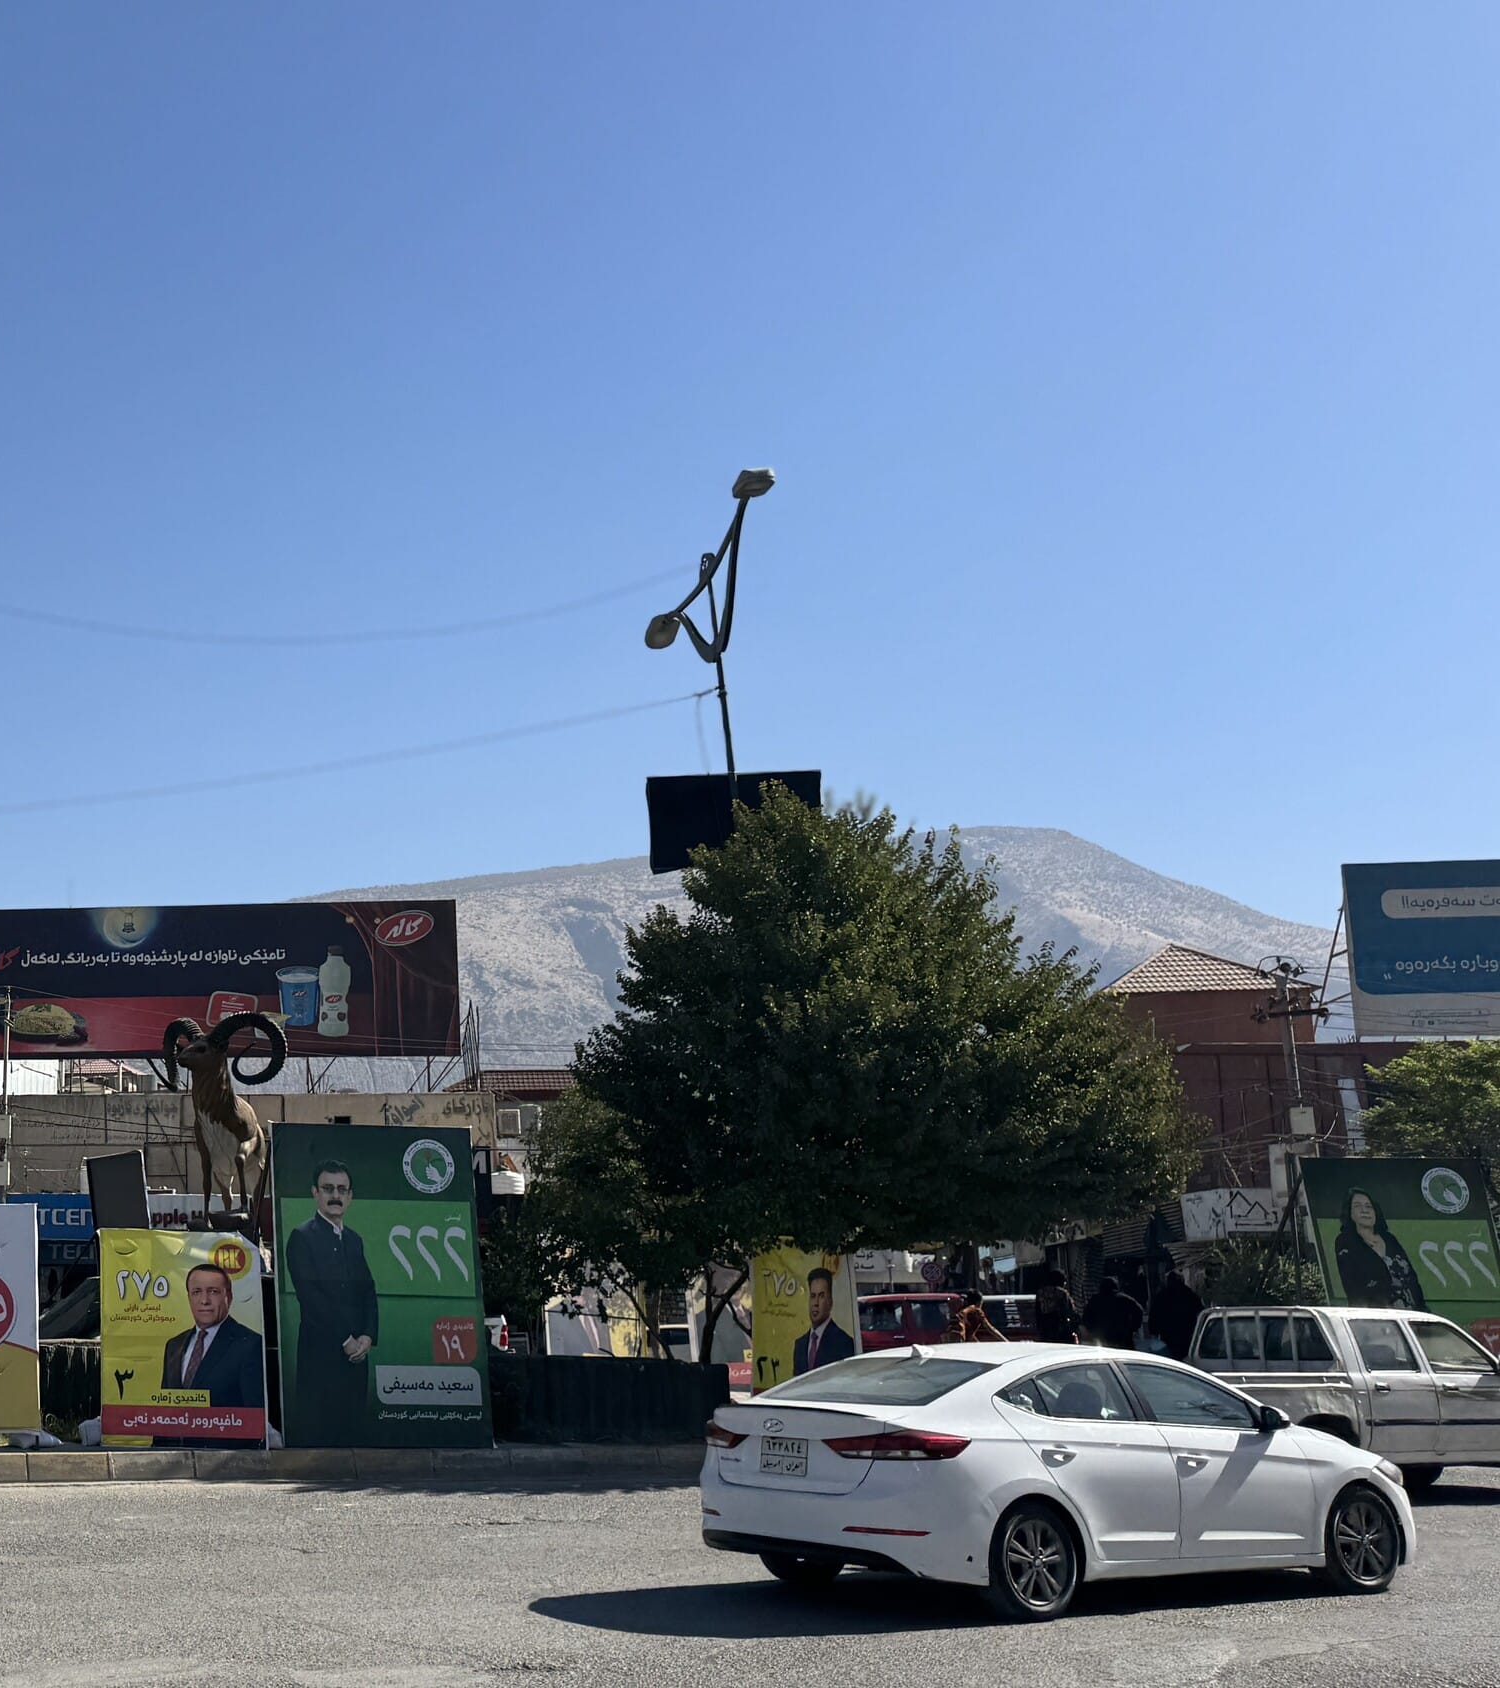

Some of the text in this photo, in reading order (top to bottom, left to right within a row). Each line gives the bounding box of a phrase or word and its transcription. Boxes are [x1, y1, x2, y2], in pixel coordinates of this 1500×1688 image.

[111, 951, 120, 964] تا
[189, 950, 204, 963] لە
[205, 949, 238, 965] ناوازە
[240, 949, 286, 965] تامێکی
[1460, 954, 1500, 972] وبارە
[152, 1209, 188, 1227] pple
[388, 1224, 468, 1282] ٢٢٢
[1418, 1240, 1498, 1289] ٢٢٢
[116, 1270, 170, 1300] ٢٧٥
[442, 1334, 466, 1360] ١٩
[114, 1368, 134, 1400] ٣
[151, 1394, 207, 1404] کاندیدی ژمارە
[123, 1412, 148, 1428] نەبی
[150, 1412, 189, 1425] ئەحمەد
